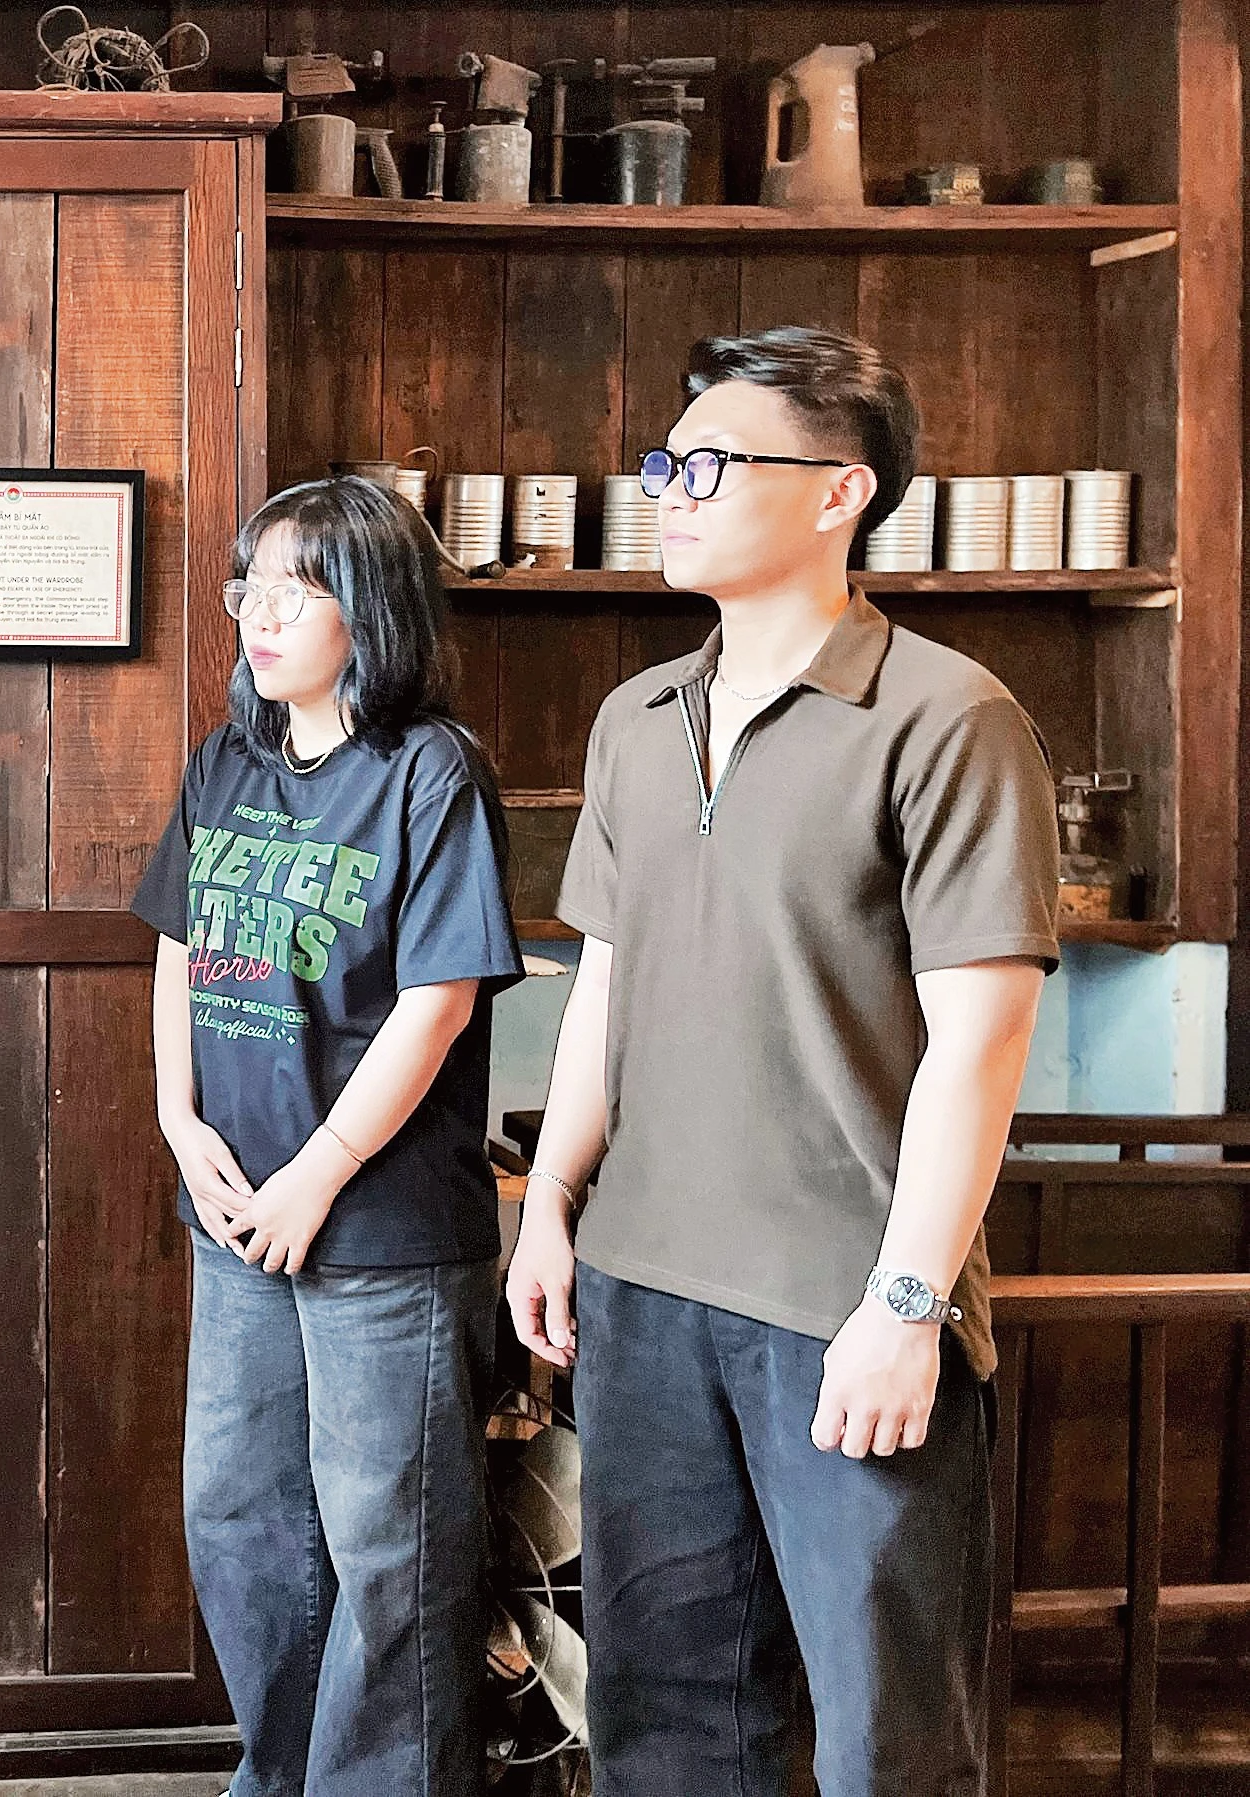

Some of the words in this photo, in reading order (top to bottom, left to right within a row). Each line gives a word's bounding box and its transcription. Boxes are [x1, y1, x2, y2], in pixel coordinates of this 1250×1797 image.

[7, 576, 30, 584] UNDER
[31, 576, 44, 584] THE
[45, 576, 85, 584] WARDROBE
[188, 931, 275, 987] Horse
